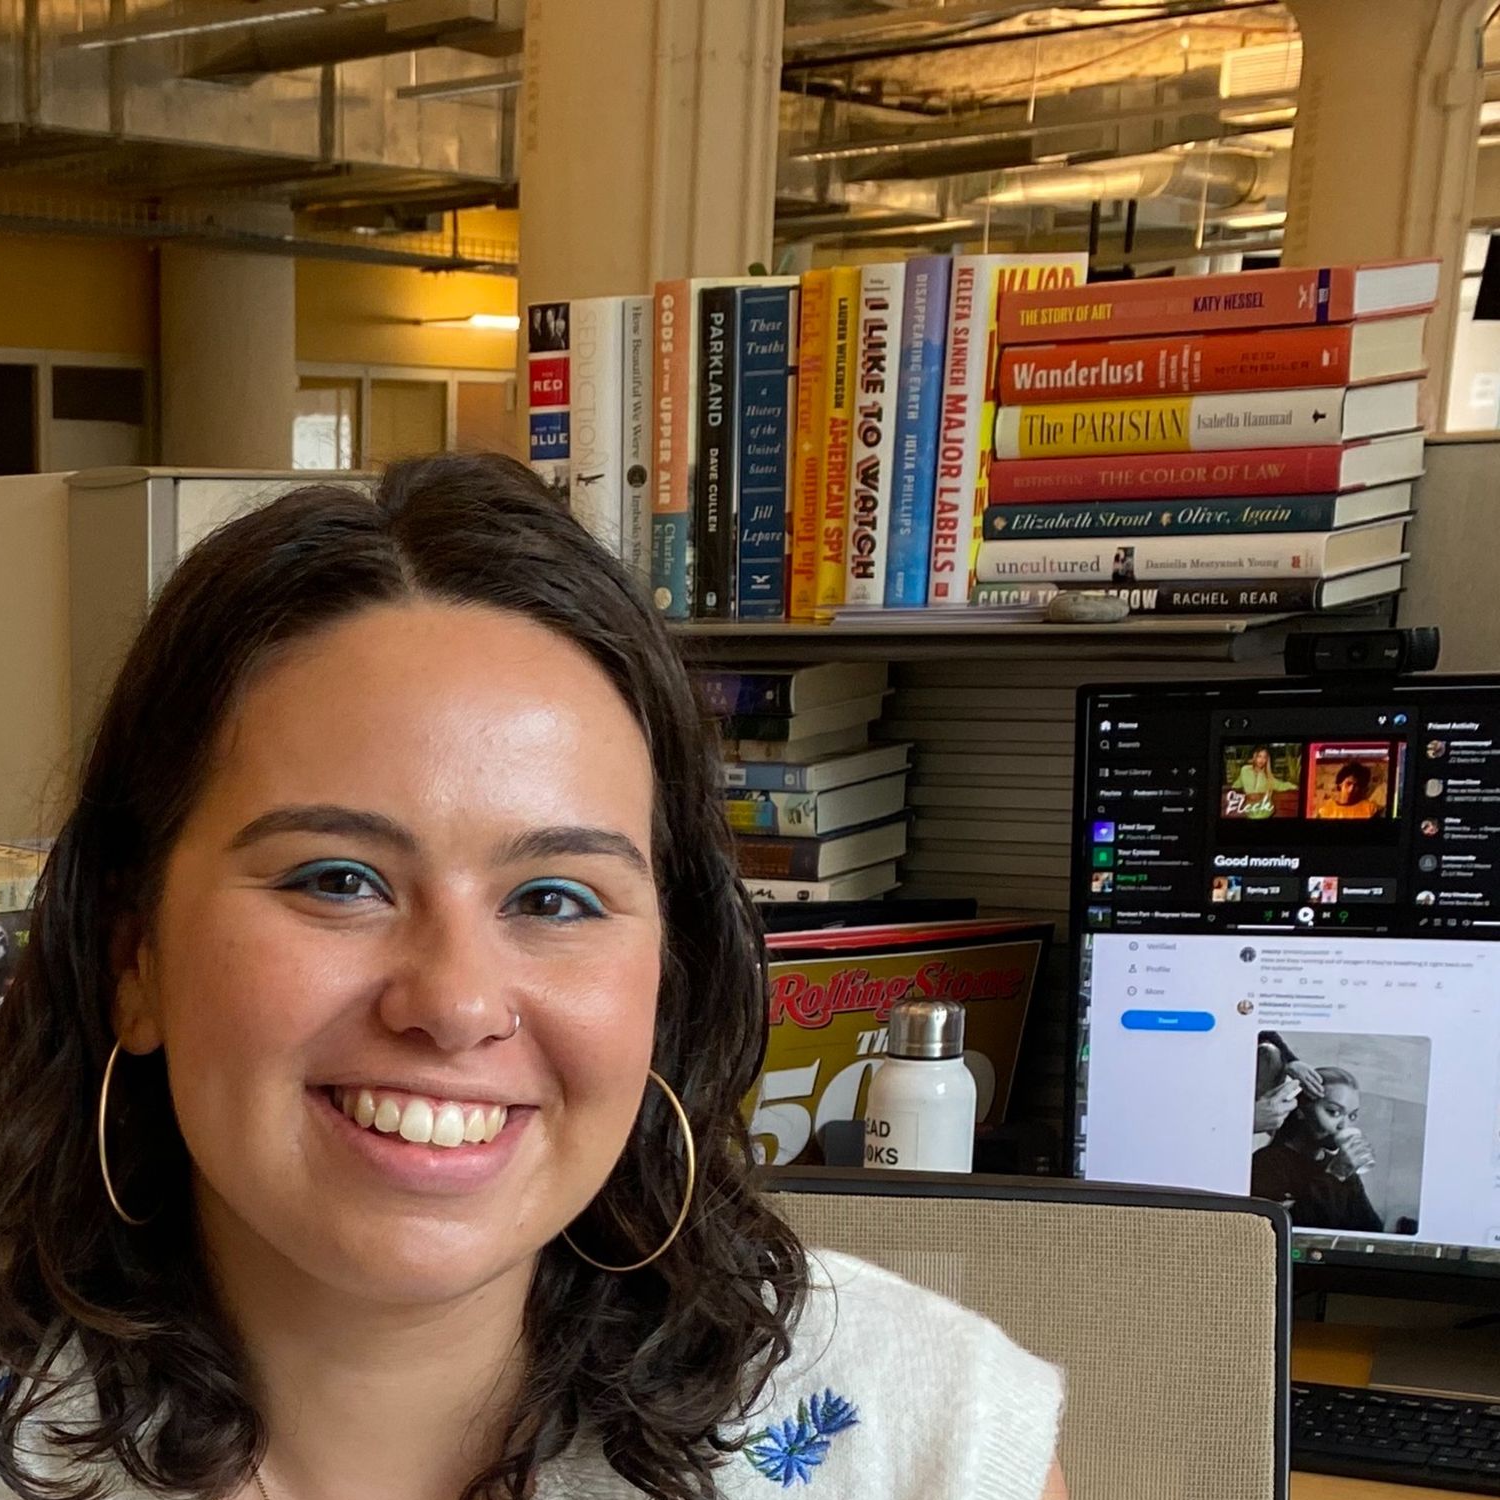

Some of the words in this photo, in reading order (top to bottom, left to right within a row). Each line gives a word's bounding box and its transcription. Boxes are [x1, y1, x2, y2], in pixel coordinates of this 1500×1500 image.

[865, 297, 889, 310] I
[955, 268, 974, 321] KELEFA
[1020, 310, 1041, 326] THE
[1042, 307, 1072, 324] STORY
[1075, 306, 1086, 322] OF
[1089, 303, 1111, 321] ART
[1194, 296, 1222, 312] KATY
[1224, 292, 1264, 310] HESSEL
[837, 299, 848, 342] LAUREN
[708, 313, 724, 427] PARKLAND
[834, 345, 847, 408] WILKINSON
[862, 318, 888, 393] LIKE
[949, 326, 970, 386] SANNEH
[1013, 359, 1144, 390] Wanderlust
[534, 380, 563, 392] RED
[532, 434, 568, 444] BLUE
[857, 403, 883, 449] TO
[939, 394, 968, 478] MAJOR
[1024, 414, 1064, 446] The
[1072, 407, 1185, 444] PARISIAN
[708, 448, 719, 482] DAVE
[826, 417, 849, 519] AMERICAN
[708, 485, 718, 533] CULLEN
[851, 456, 880, 580] WATCH
[823, 525, 842, 564] SPY
[933, 491, 960, 573] LABELS
[996, 555, 1101, 575] uncultured
[1173, 591, 1229, 607] RACHEL
[1240, 590, 1278, 604] REAR
[1214, 855, 1248, 867] Good
[1250, 856, 1299, 869] morning
[769, 968, 914, 1029] Rolling
[916, 961, 1024, 1000] Stone
